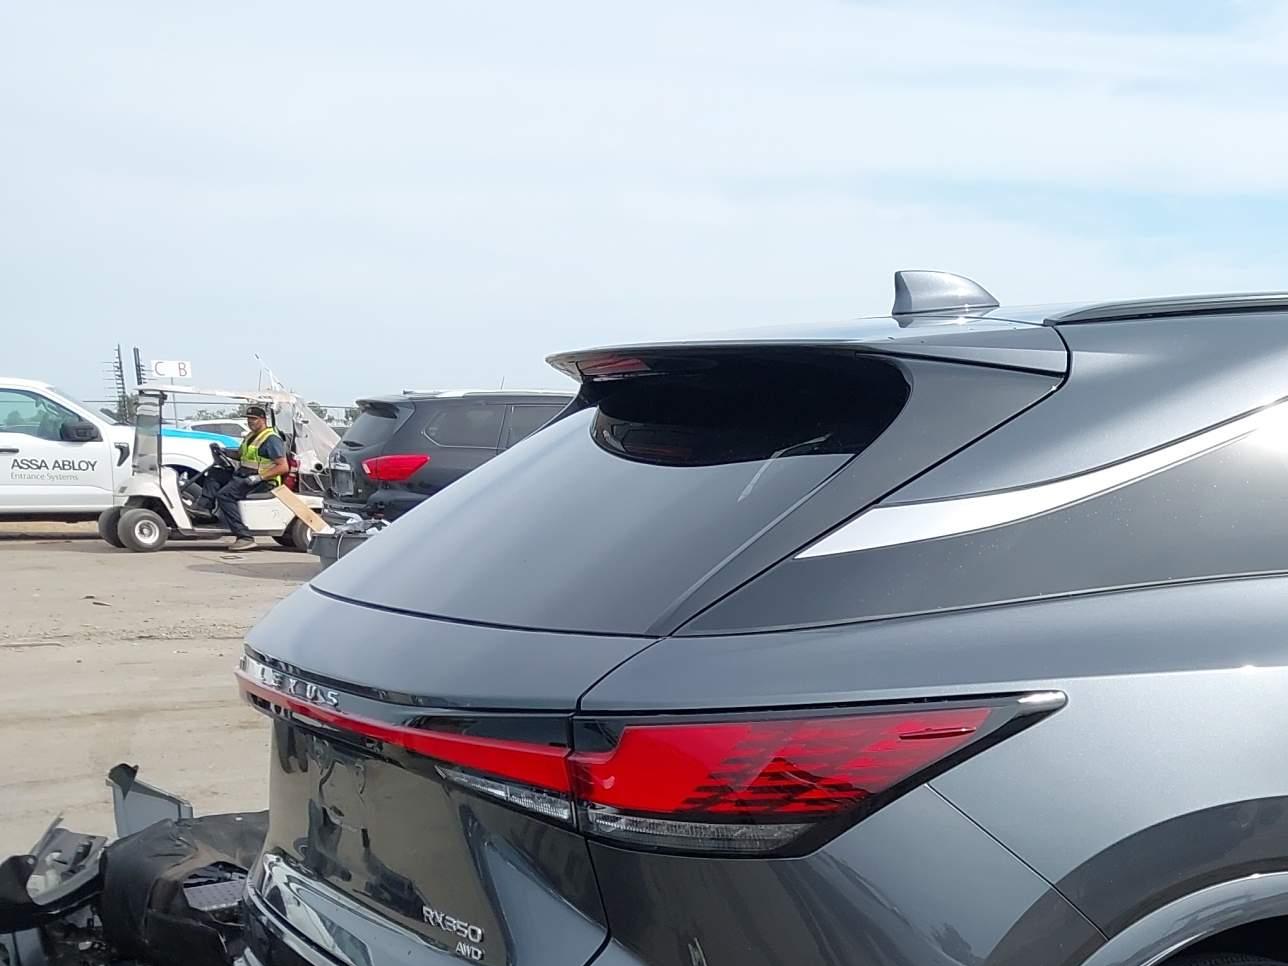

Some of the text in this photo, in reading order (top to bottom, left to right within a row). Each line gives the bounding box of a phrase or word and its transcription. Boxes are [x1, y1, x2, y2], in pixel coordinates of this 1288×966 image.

[154, 361, 188, 377] C B
[10, 458, 98, 472] ASSA ABLOY
[10, 472, 80, 482] Entrance Systems
[258, 666, 340, 707] LEXUS
[422, 905, 484, 943] RX350
[455, 941, 484, 961] AWD
